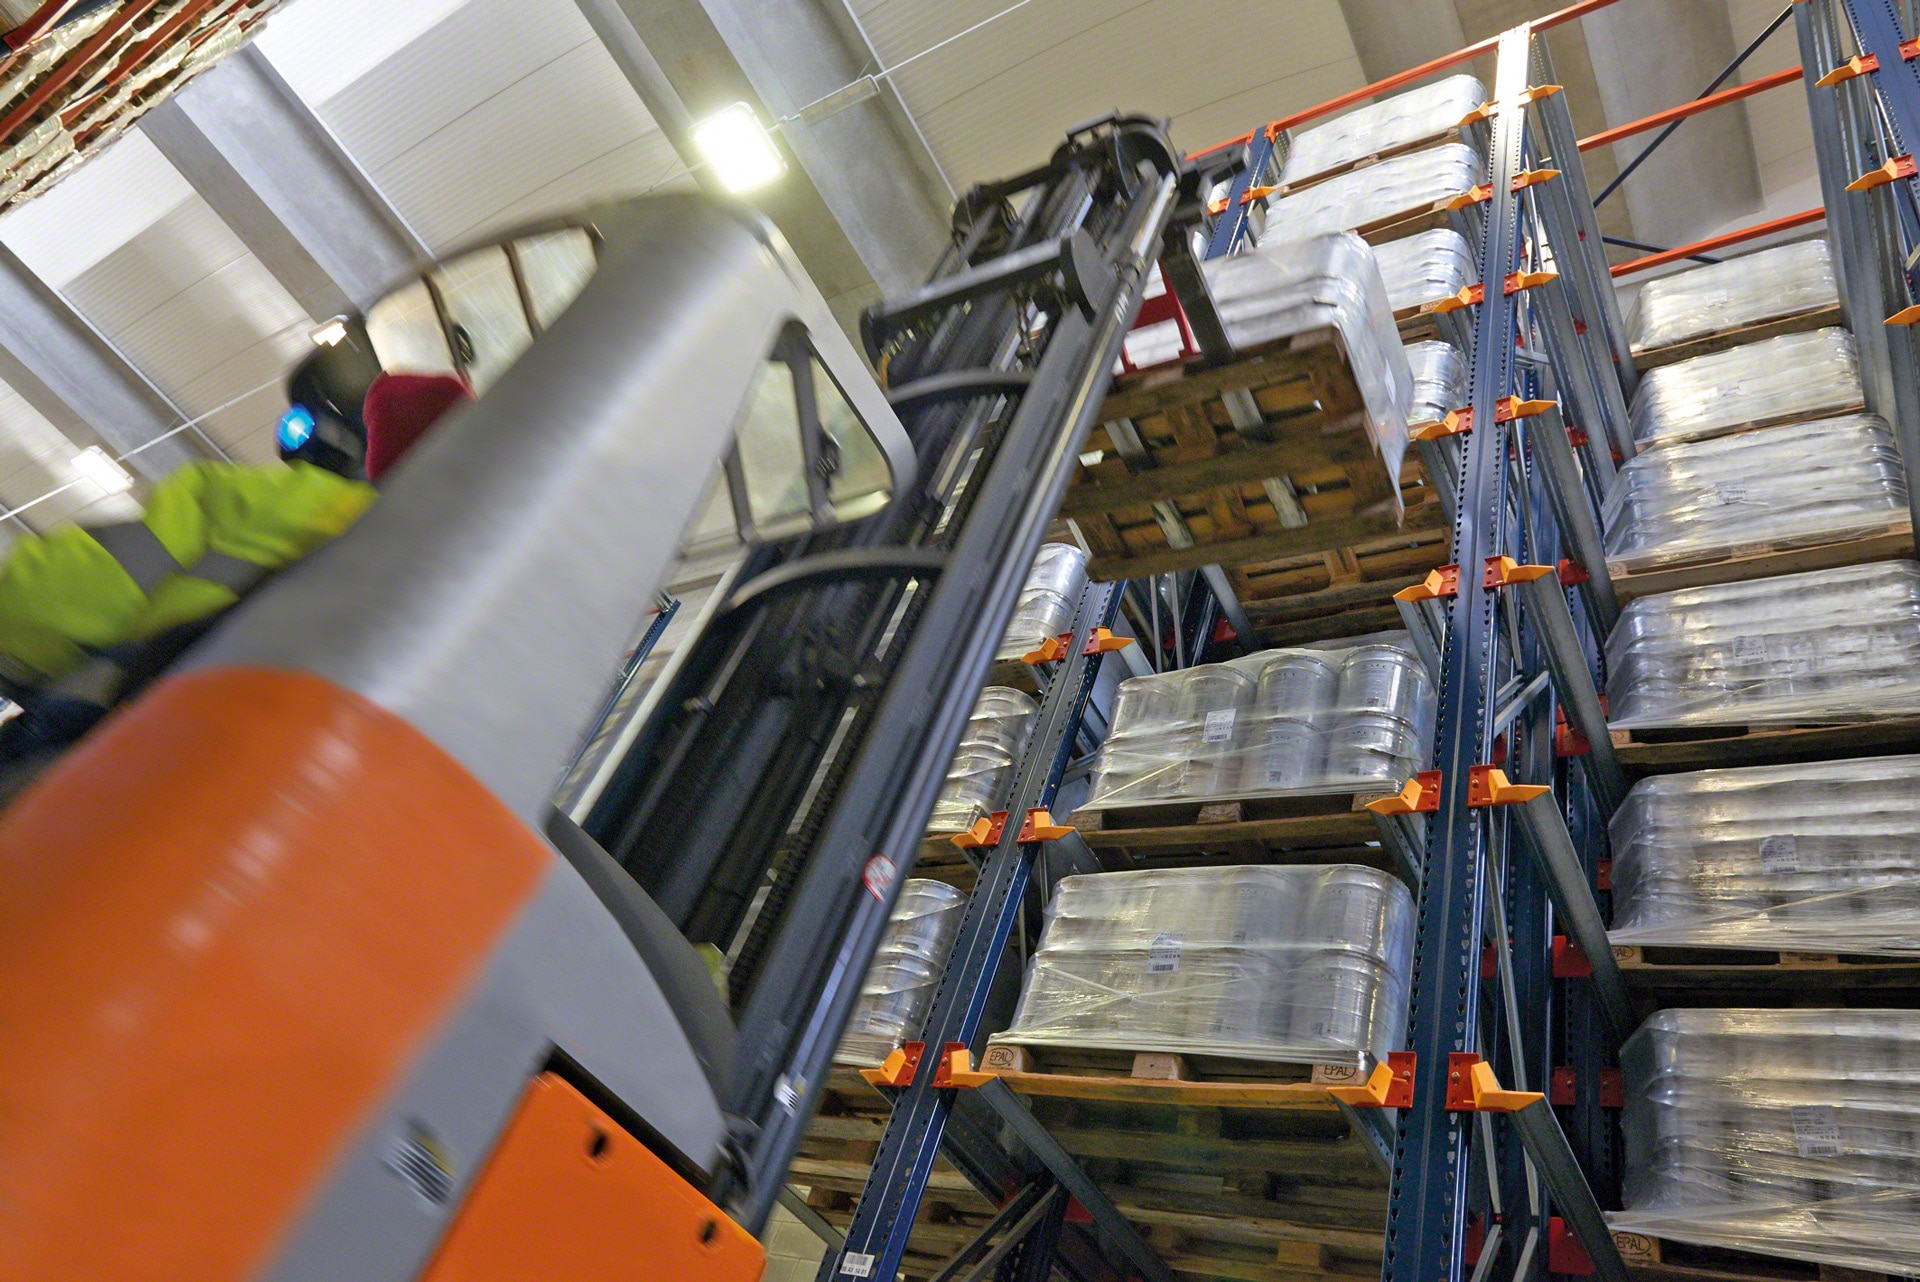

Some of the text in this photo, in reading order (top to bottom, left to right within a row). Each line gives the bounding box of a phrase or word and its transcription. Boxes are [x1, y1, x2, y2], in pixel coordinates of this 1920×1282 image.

[990, 1051, 1009, 1062] EPAL
[1324, 1064, 1350, 1077] EPAL
[1617, 1235, 1646, 1251] EPAL
